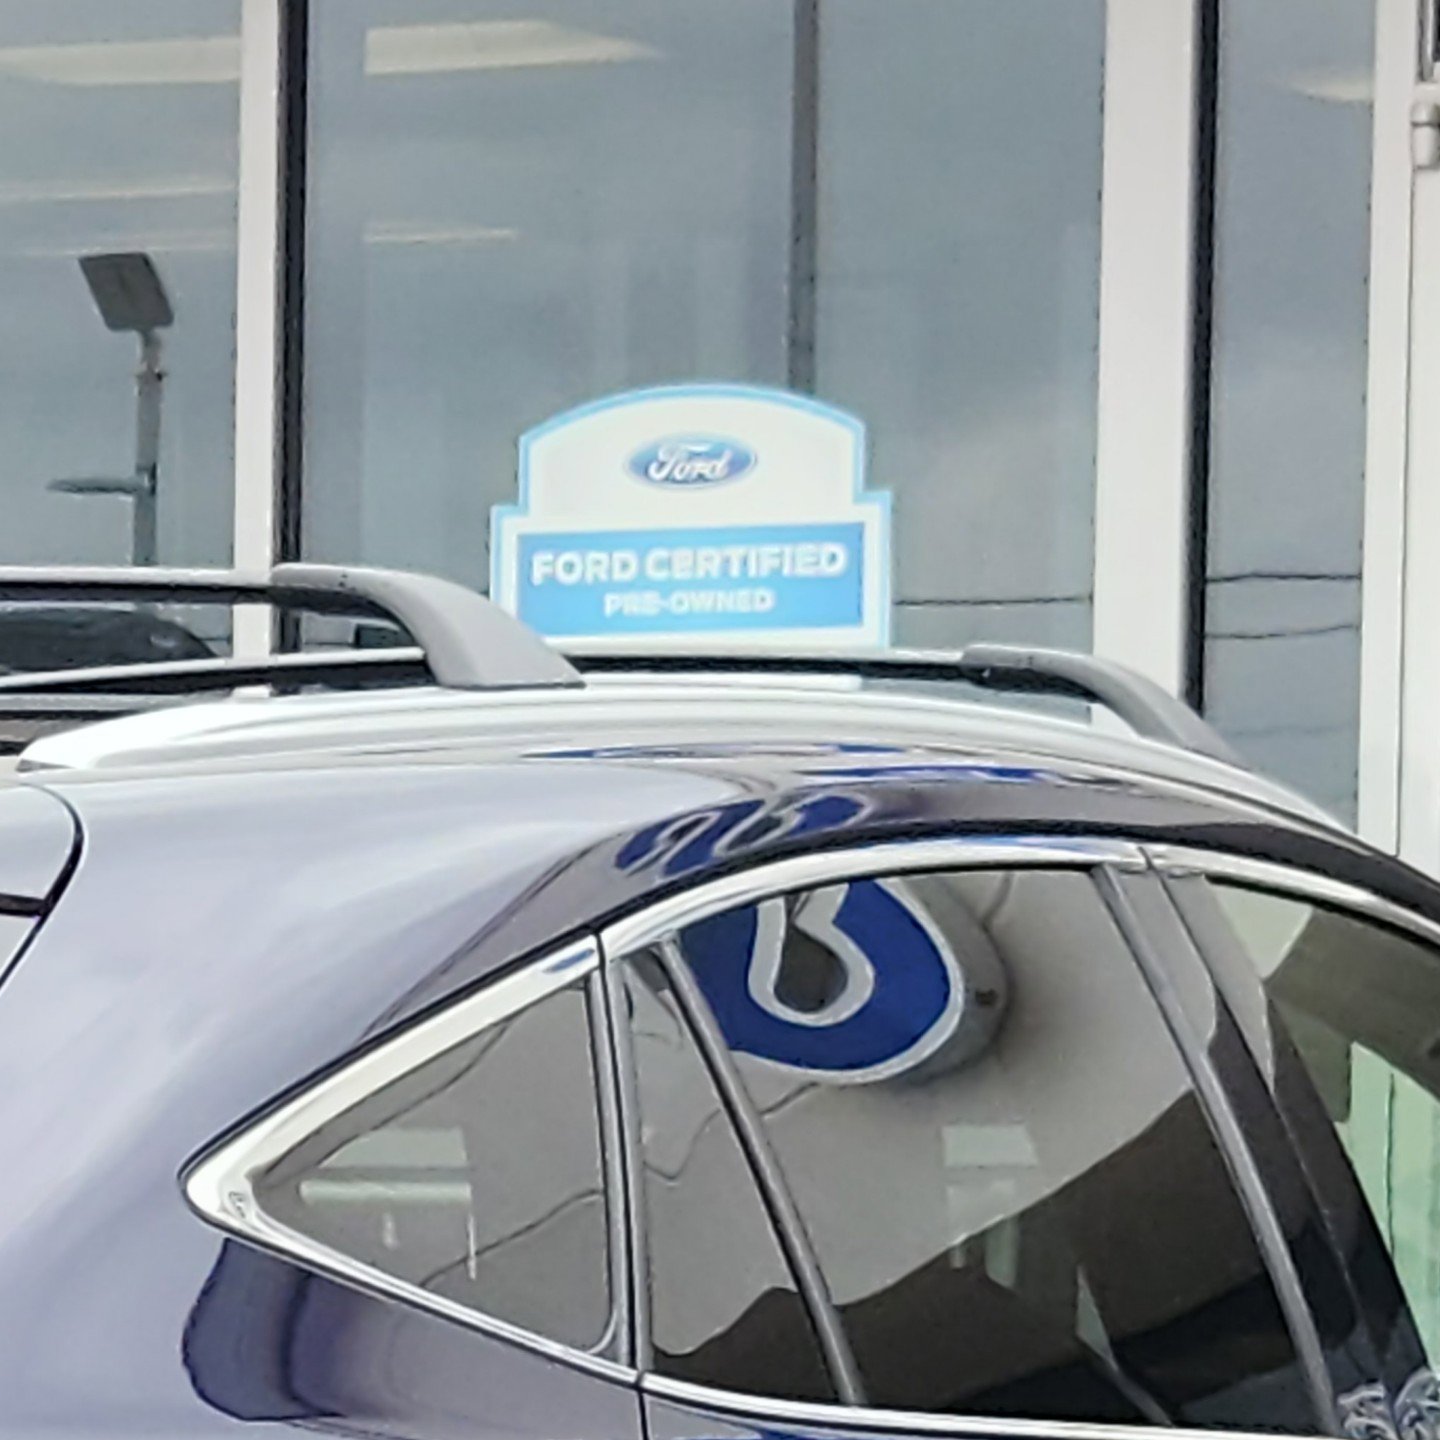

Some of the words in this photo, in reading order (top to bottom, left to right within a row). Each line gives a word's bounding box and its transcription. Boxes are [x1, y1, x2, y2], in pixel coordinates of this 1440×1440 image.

[646, 443, 731, 482] Ford
[531, 549, 637, 586] FORD
[645, 542, 849, 581] CERTIFIED
[604, 588, 776, 618] PRE-OWNED
